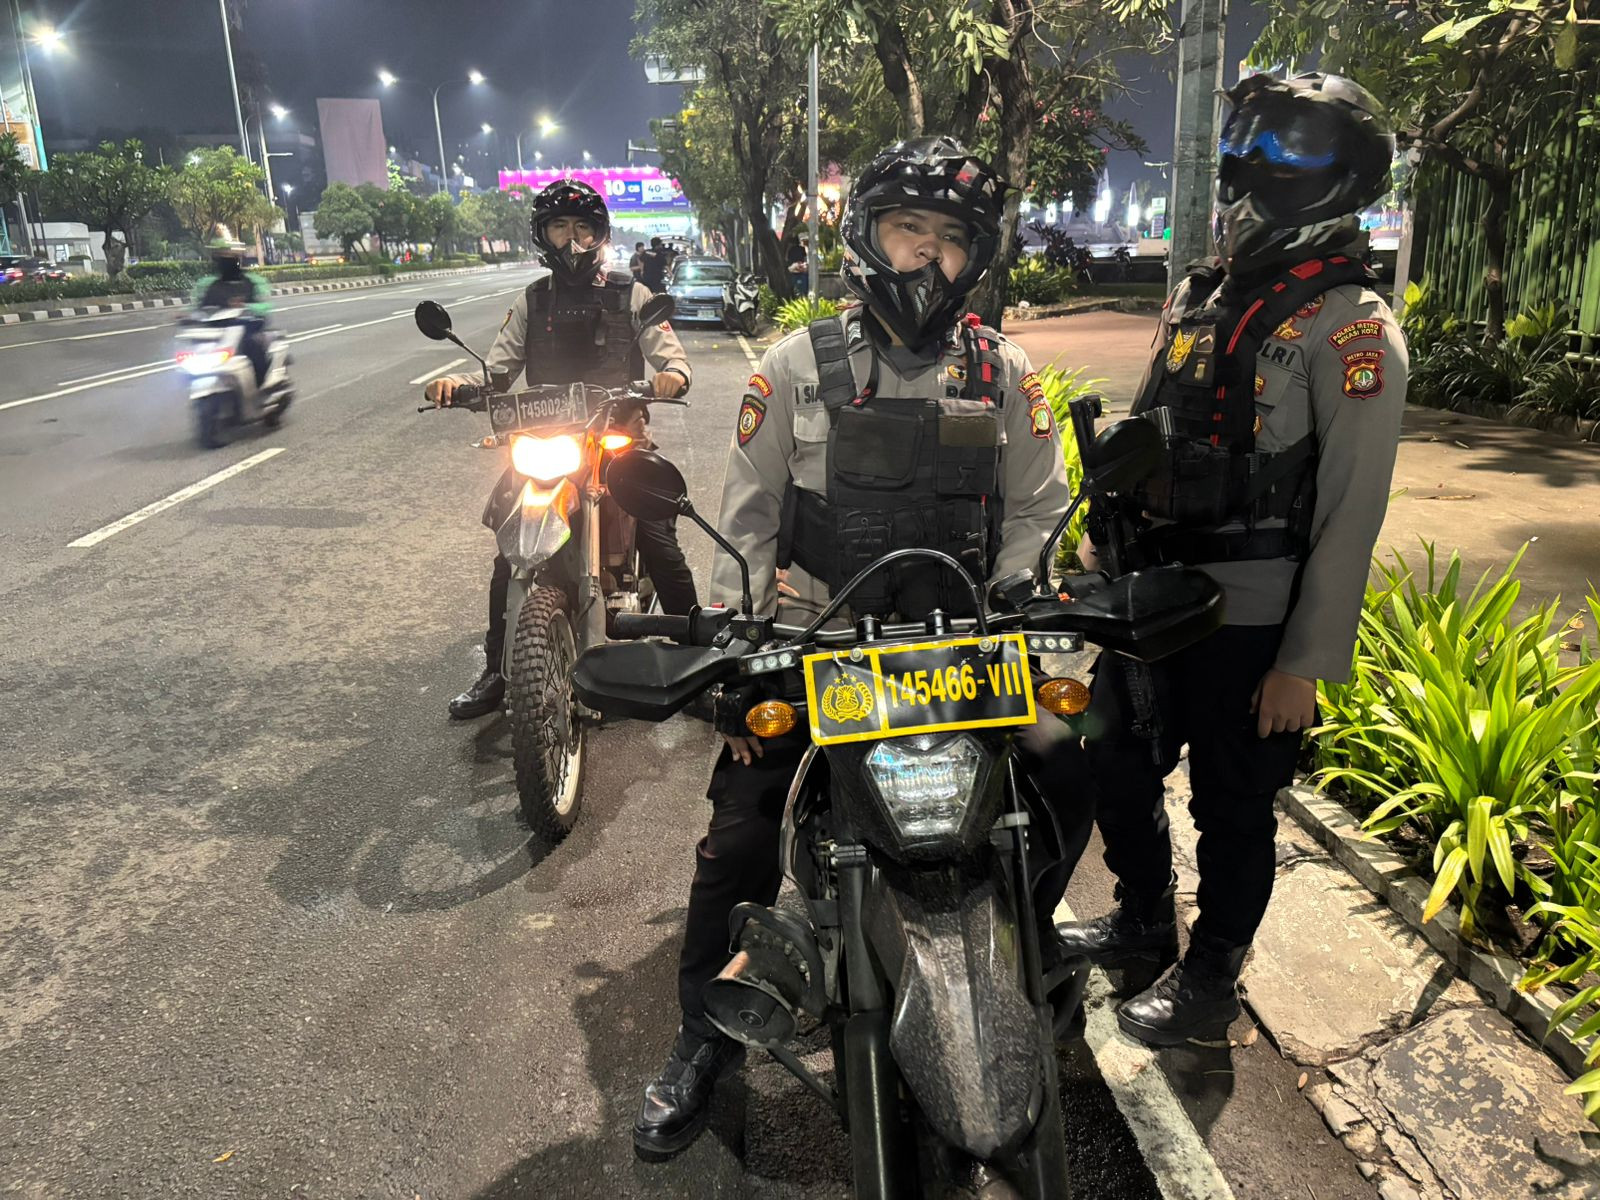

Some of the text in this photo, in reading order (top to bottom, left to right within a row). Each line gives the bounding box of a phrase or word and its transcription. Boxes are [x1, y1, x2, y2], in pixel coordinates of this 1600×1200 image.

[604, 179, 626, 196] 10
[1332, 322, 1379, 341] POLRES METRO
[1337, 330, 1360, 345] BEKASI
[1261, 342, 1296, 366] LRI
[803, 384, 825, 404] SIA
